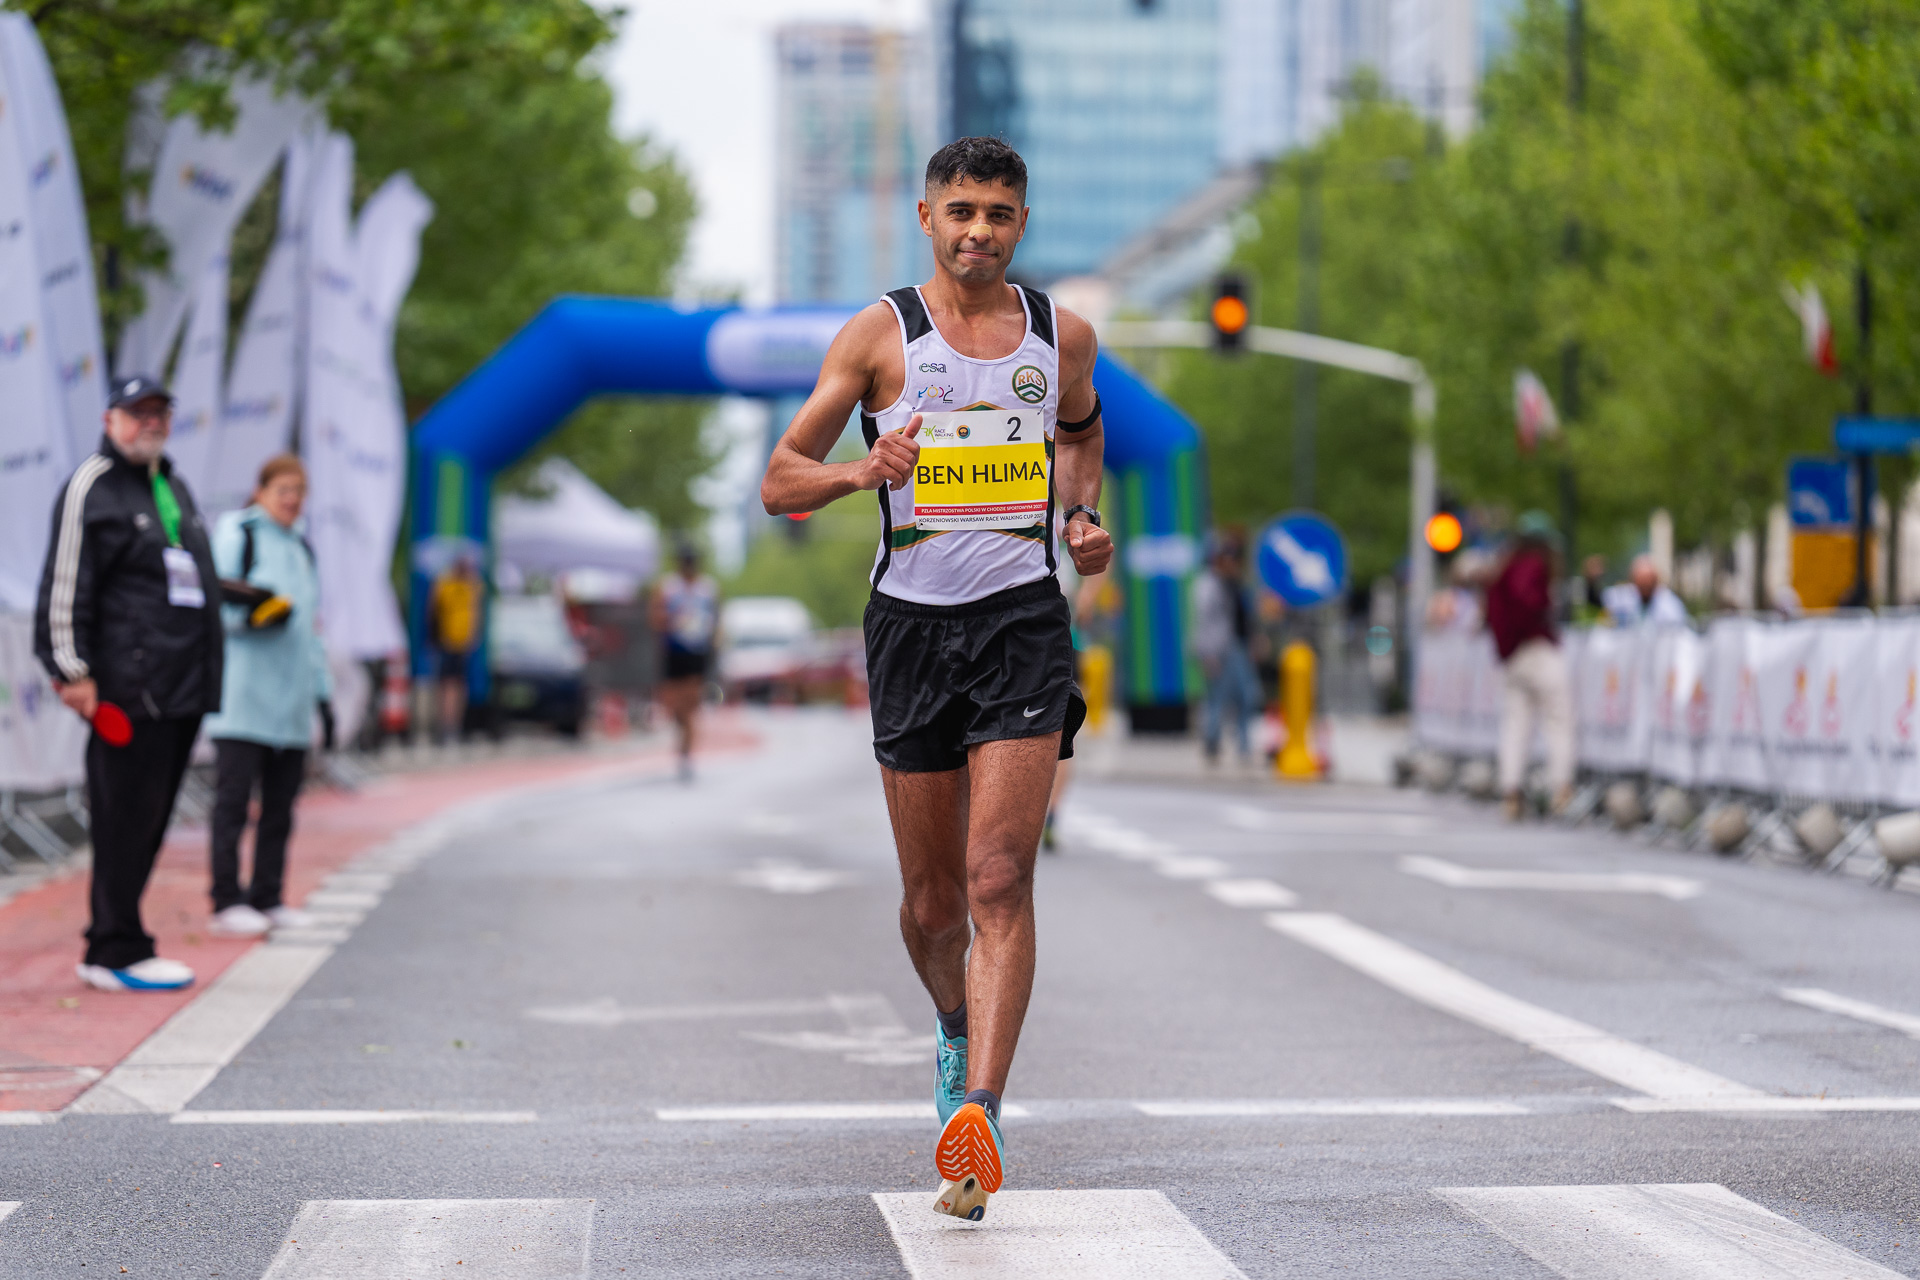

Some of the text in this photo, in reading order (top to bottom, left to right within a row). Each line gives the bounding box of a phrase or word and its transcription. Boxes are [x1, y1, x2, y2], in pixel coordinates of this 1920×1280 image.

[918, 362, 948, 373] esa
[1018, 371, 1043, 386] RKS
[1006, 416, 1022, 442] 2
[916, 461, 1046, 484] BEN HLIMA
